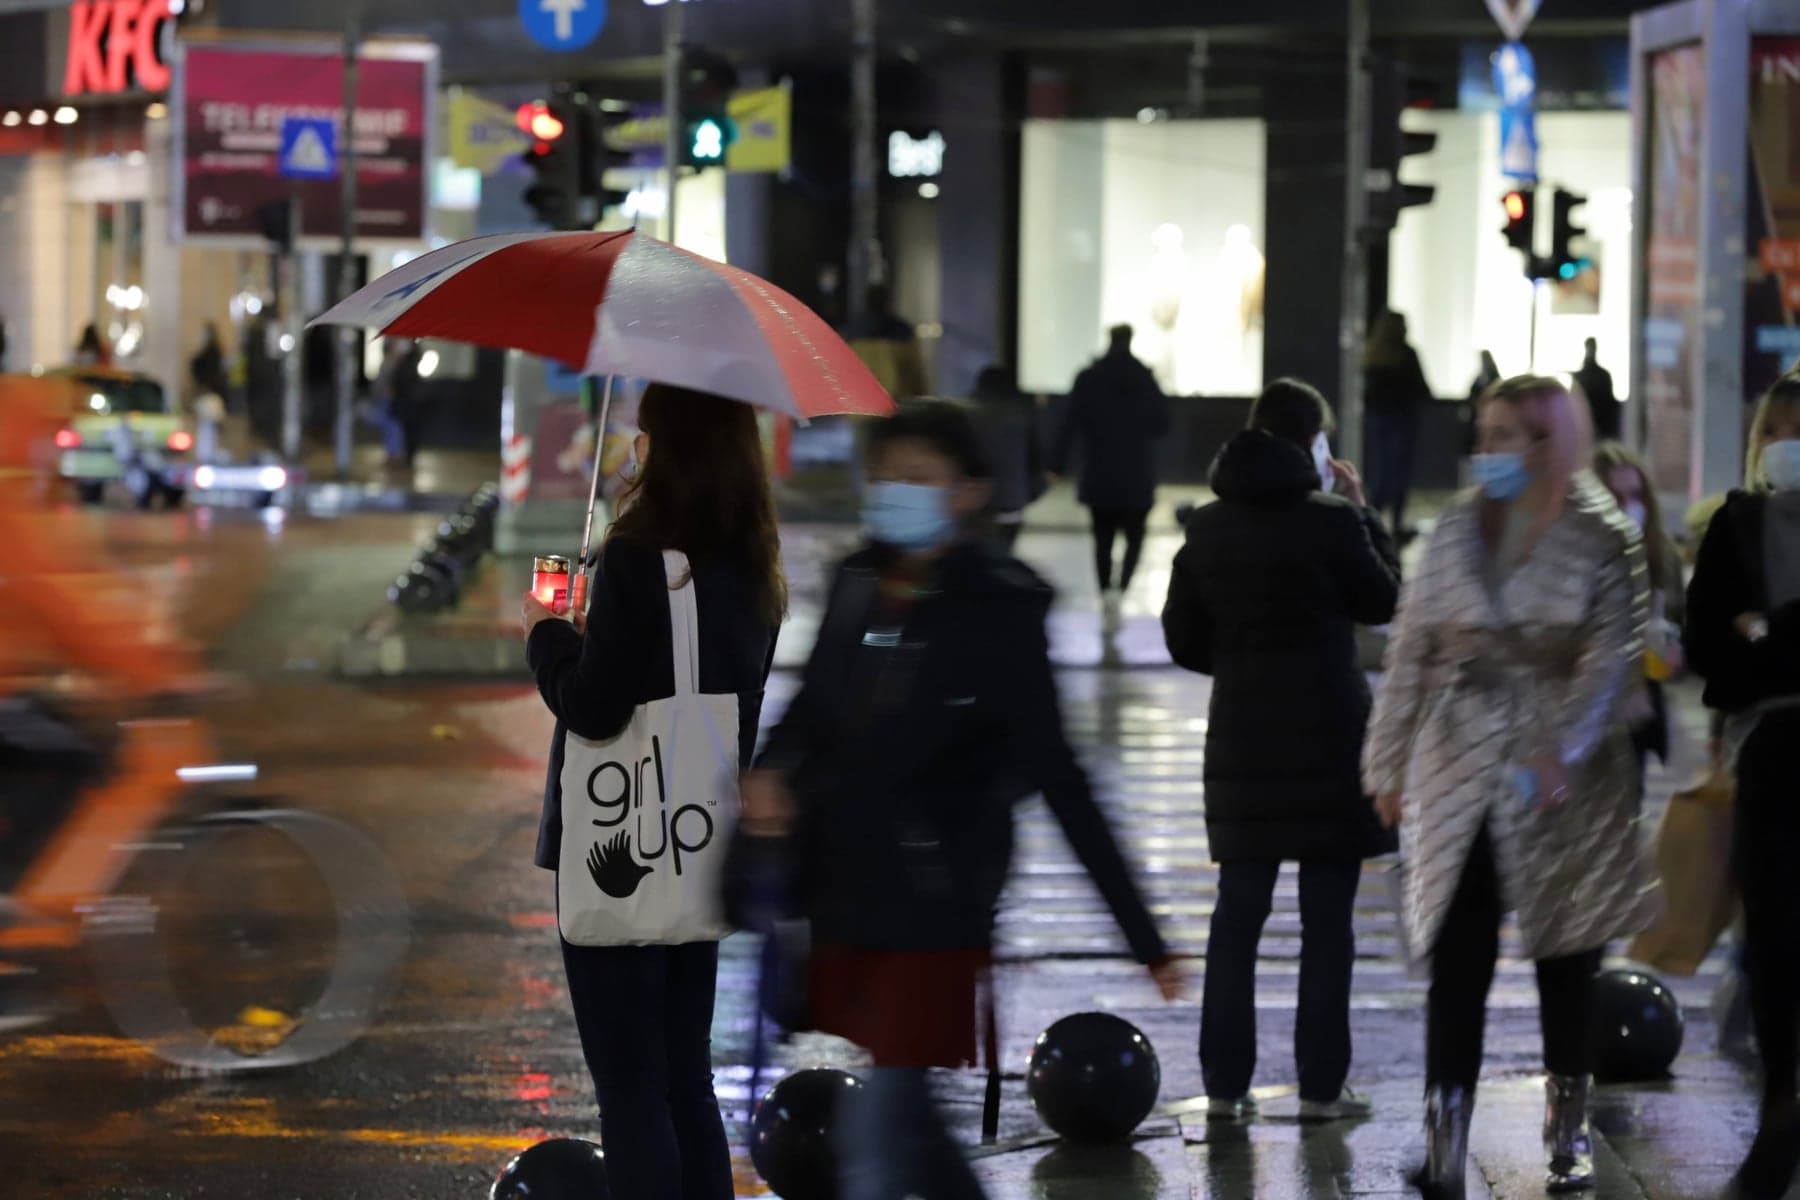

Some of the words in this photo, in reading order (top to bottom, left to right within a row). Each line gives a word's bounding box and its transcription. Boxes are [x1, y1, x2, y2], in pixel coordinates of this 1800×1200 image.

[63, 0, 172, 96] KFC
[587, 735, 665, 827] girl
[637, 804, 714, 876] up
